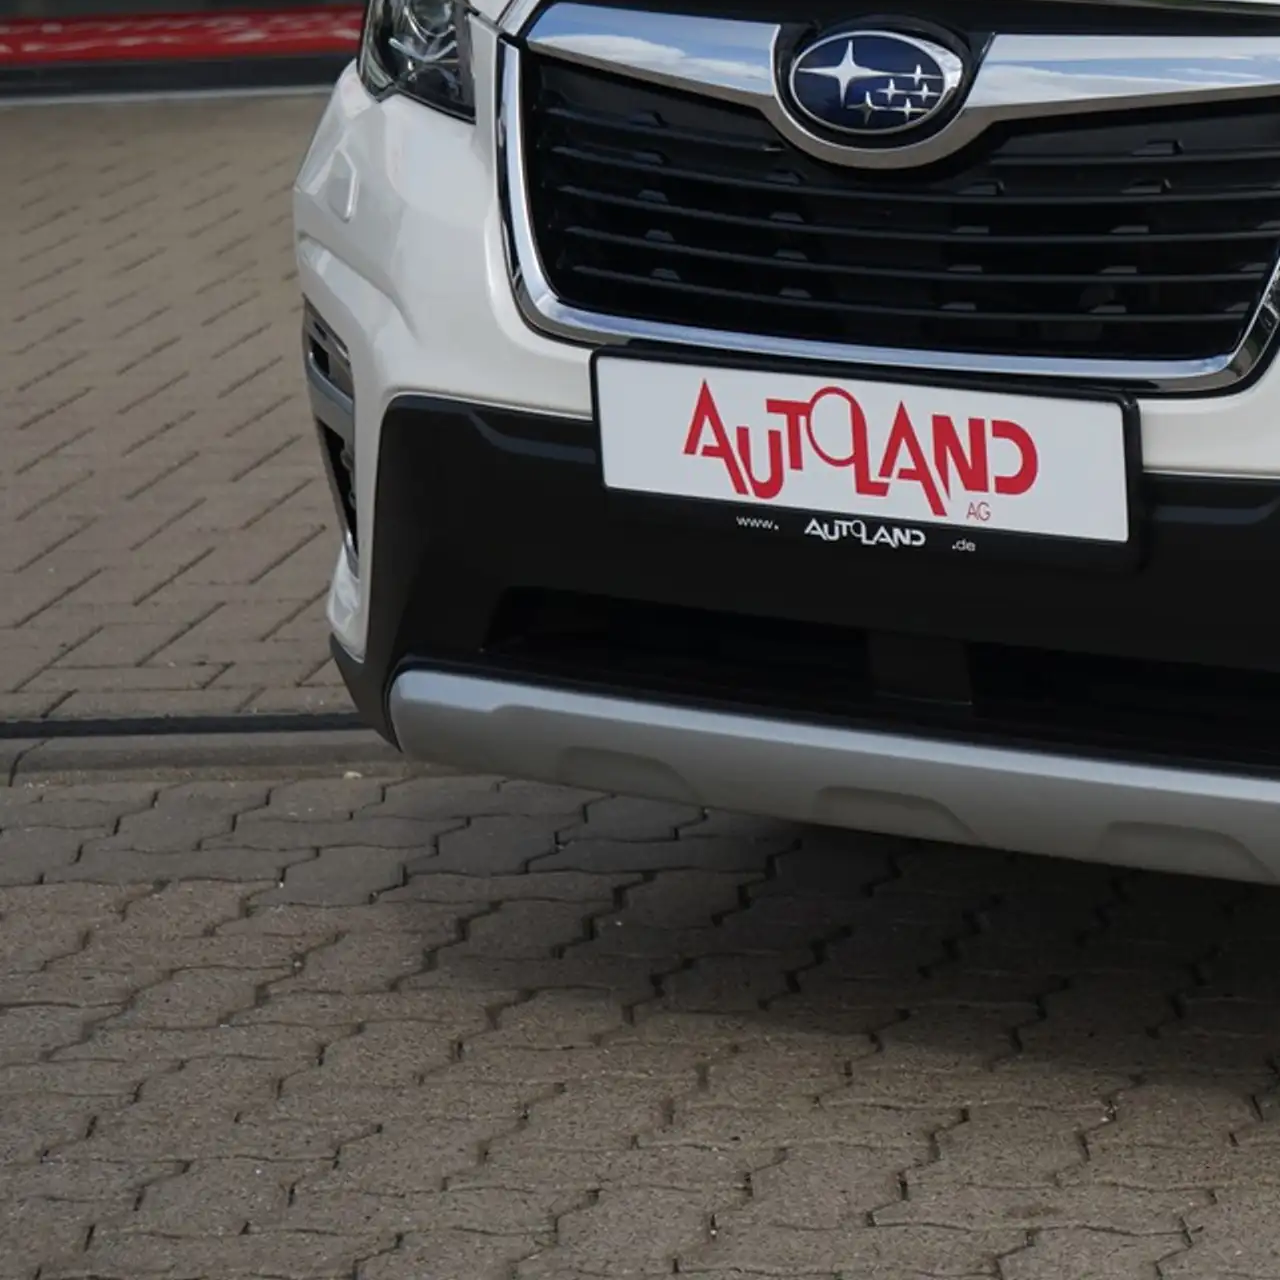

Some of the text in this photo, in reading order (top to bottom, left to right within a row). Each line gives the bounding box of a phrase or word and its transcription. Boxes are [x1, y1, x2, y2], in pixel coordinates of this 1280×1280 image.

[684, 380, 1038, 516] AUTOLAND
[966, 502, 991, 522] AG
[736, 516, 779, 530] www.
[804, 518, 926, 548] AUTOLAND
